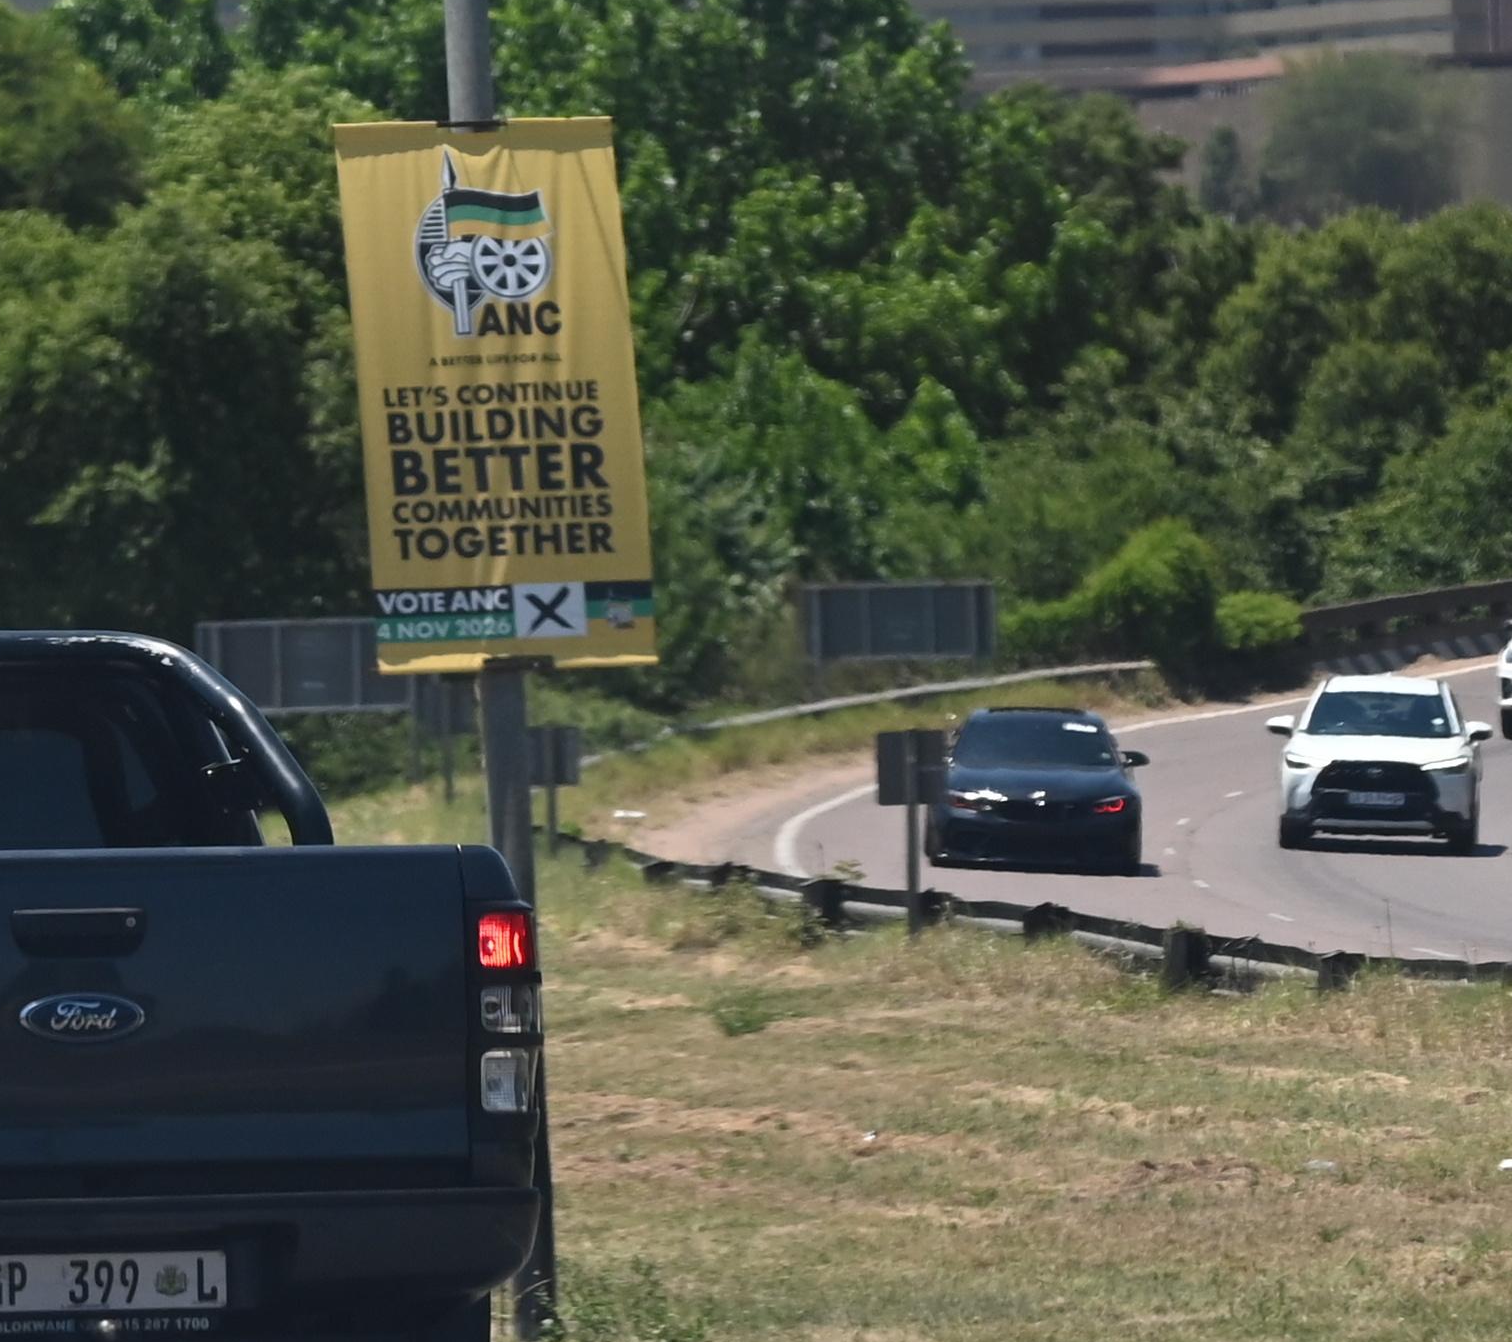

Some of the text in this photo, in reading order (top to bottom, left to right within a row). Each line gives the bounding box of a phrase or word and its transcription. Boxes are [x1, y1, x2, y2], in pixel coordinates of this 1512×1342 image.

[478, 301, 561, 336] ANC
[383, 380, 598, 408] LET'S CONTINUE
[387, 405, 603, 444] BUILDING
[391, 443, 609, 496] BETTER
[392, 494, 613, 524] COMMUNITIES
[393, 522, 615, 560] TOGETHER
[377, 588, 510, 614] VOTE ANC
[377, 616, 512, 639] 4 NOV 2026
[50, 1001, 117, 1031] Ford
[69, 1259, 139, 1304] 399
[197, 1257, 218, 1302] L
[177, 1317, 210, 1330] 1700
